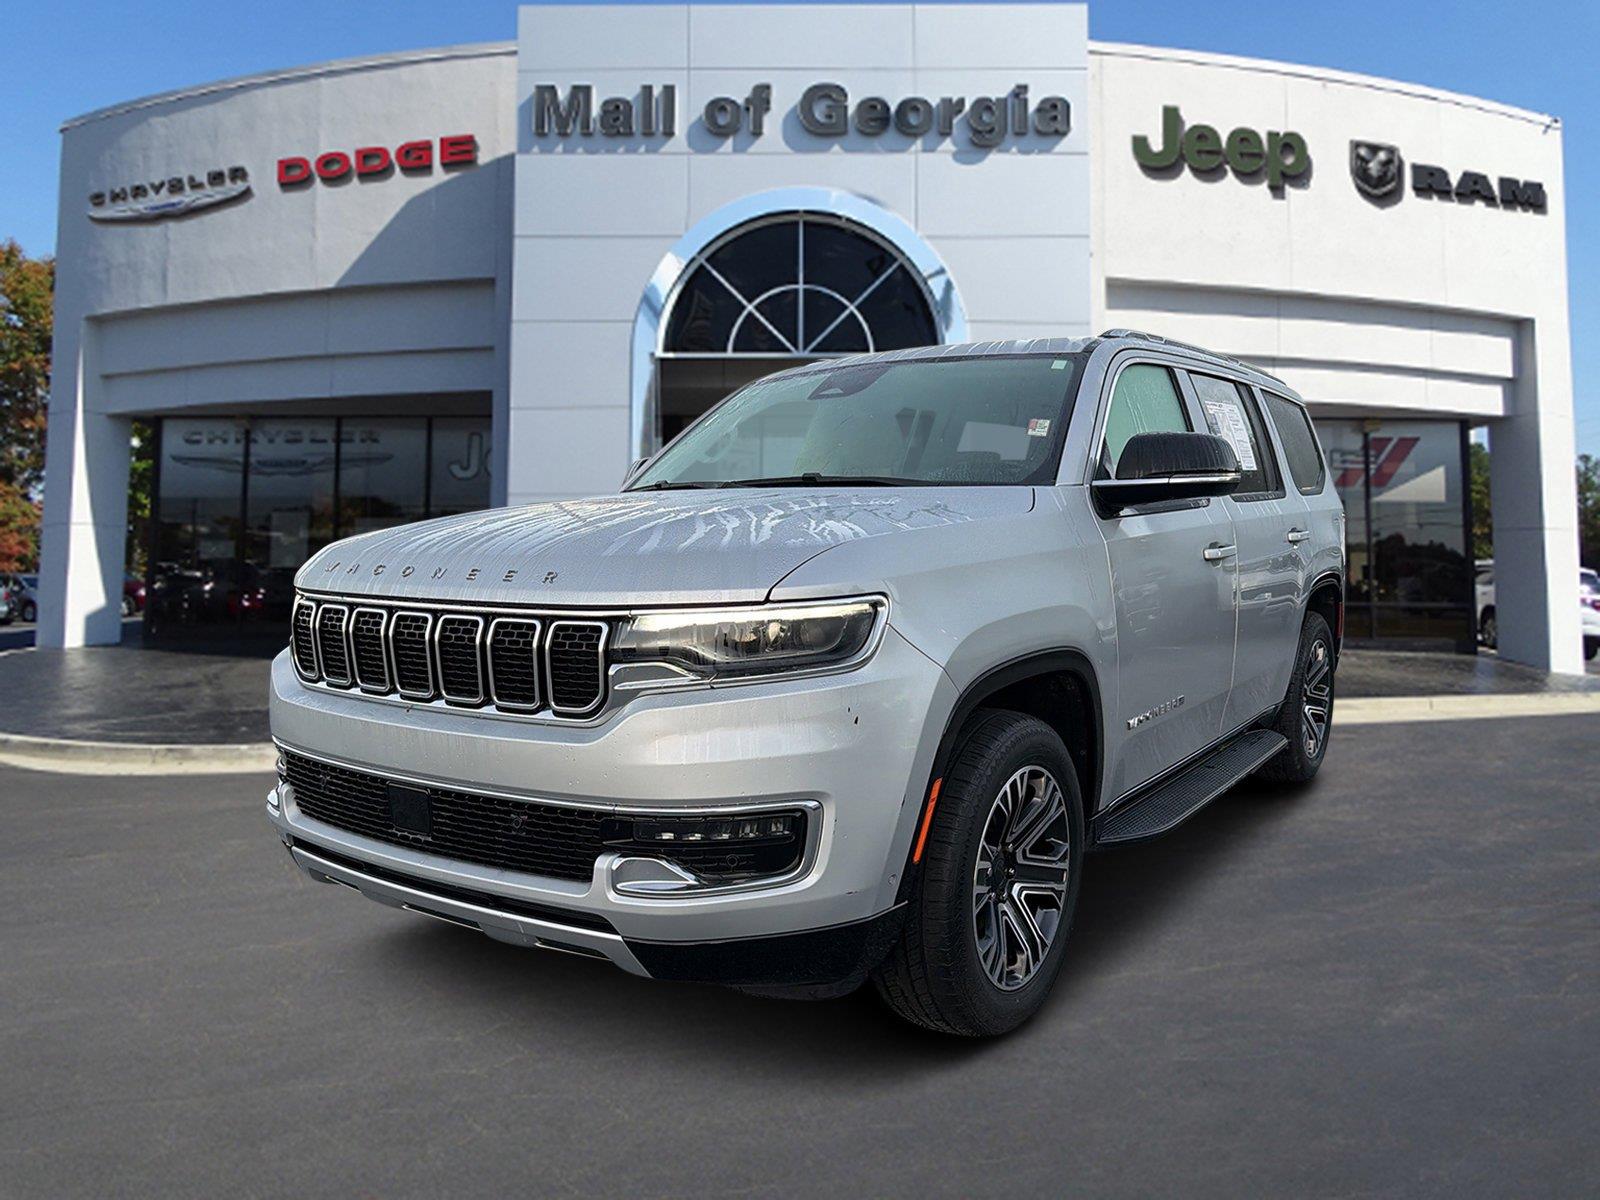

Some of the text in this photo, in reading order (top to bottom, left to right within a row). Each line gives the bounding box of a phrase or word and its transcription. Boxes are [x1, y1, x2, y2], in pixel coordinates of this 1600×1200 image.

[532, 82, 1072, 149] Mall of Georgia
[277, 134, 477, 187] DODGE
[1132, 105, 1309, 189] Jeep
[89, 165, 249, 207] CHRYSLER
[1411, 162, 1547, 213] RAM
[325, 560, 559, 584] WAGONEER
